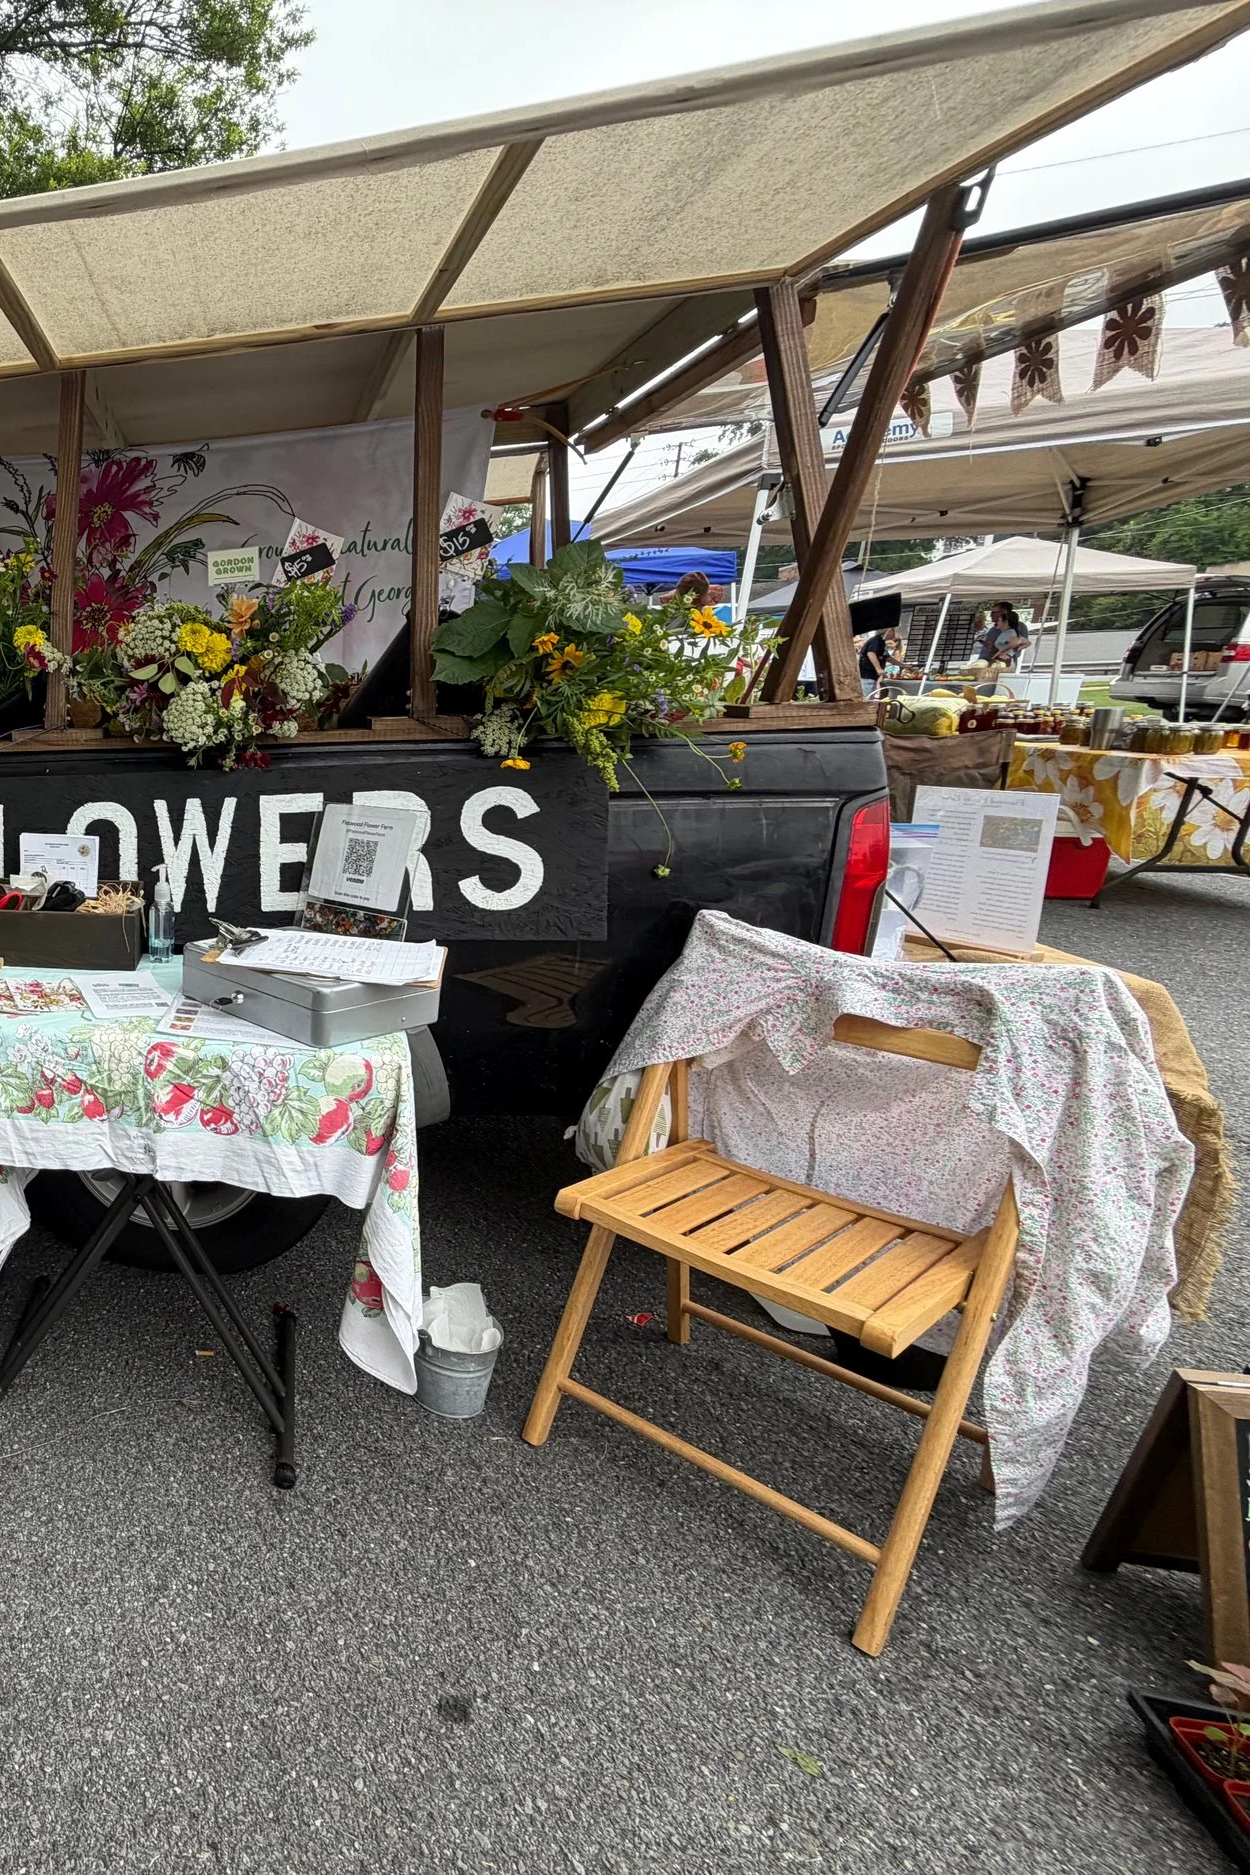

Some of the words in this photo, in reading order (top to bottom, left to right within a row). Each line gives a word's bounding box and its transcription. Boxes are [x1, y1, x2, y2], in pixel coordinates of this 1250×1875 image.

[833, 421, 918, 443] Aemy
[212, 556, 254, 568] GORDON
[214, 564, 252, 575] GROWN
